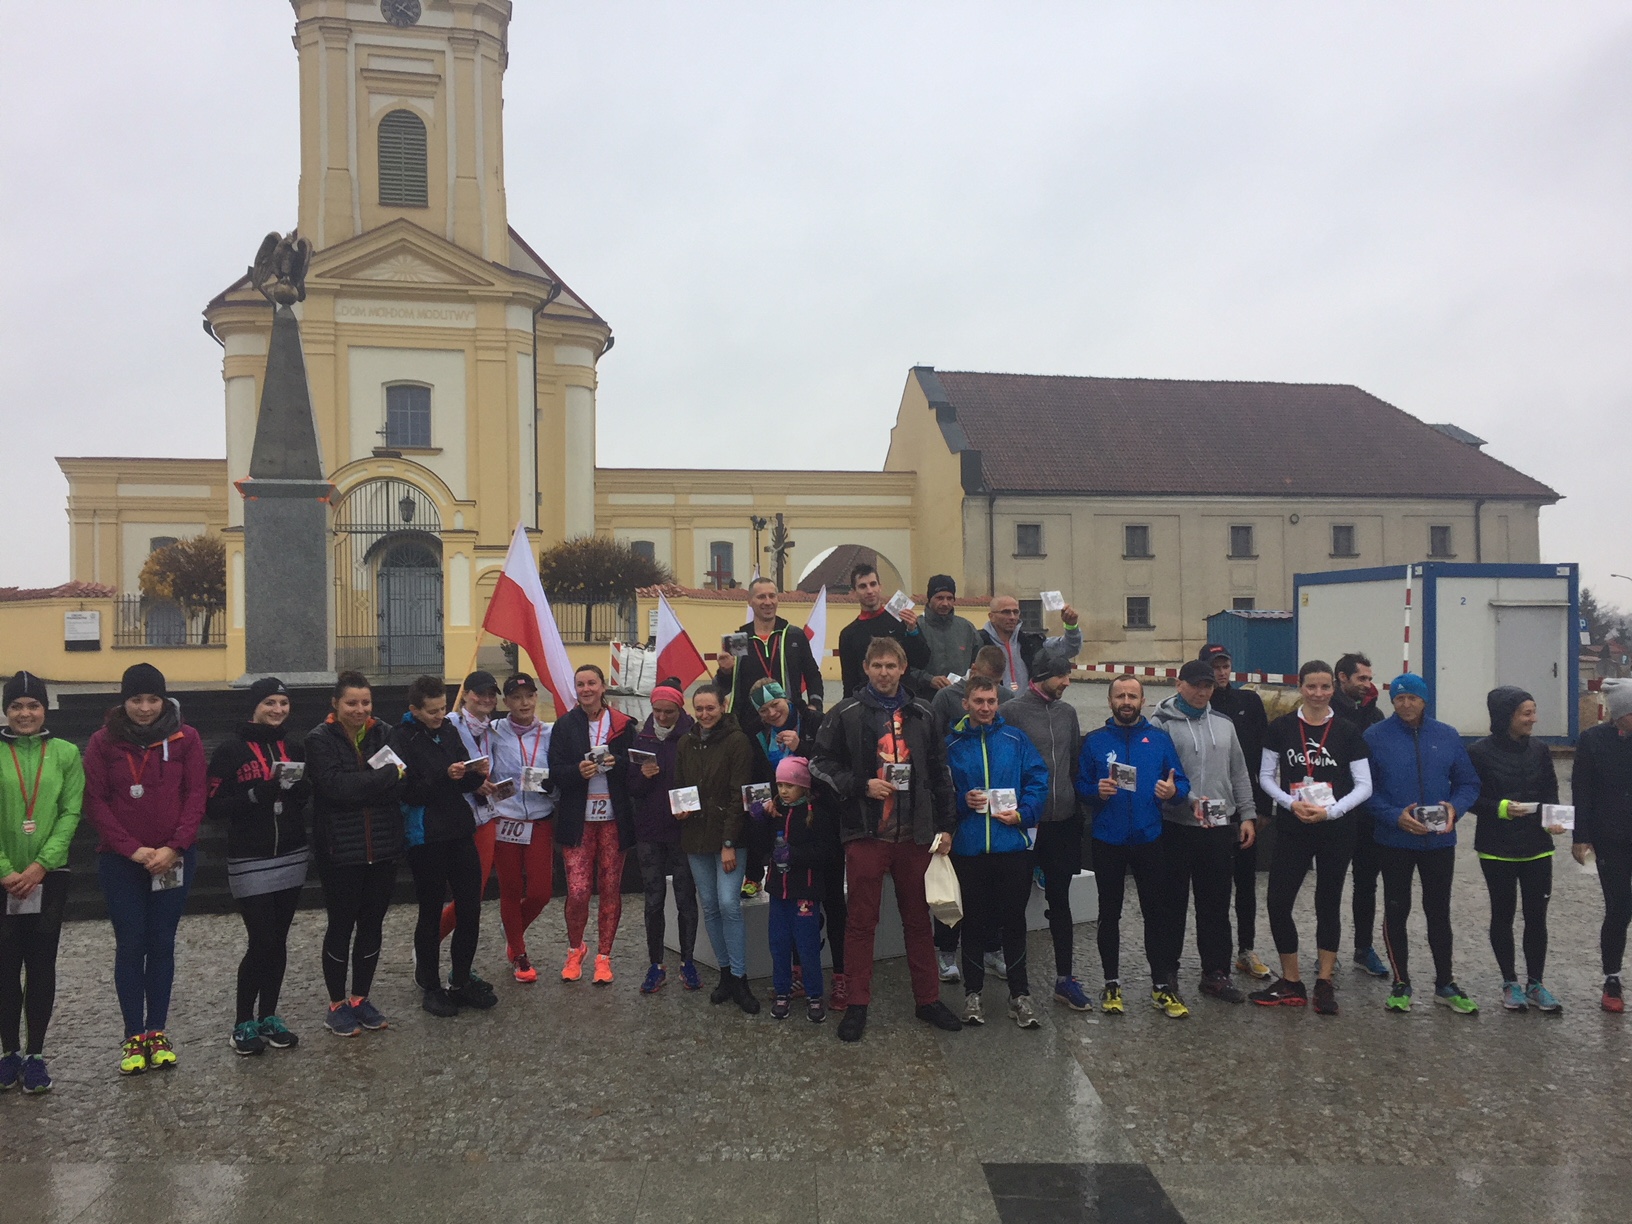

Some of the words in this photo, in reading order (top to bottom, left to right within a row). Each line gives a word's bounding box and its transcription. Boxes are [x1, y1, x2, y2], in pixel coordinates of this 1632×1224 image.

[1460, 596, 1467, 606] 2
[1579, 619, 1586, 629] P
[591, 799, 607, 815] 12
[501, 820, 525, 837] 110
